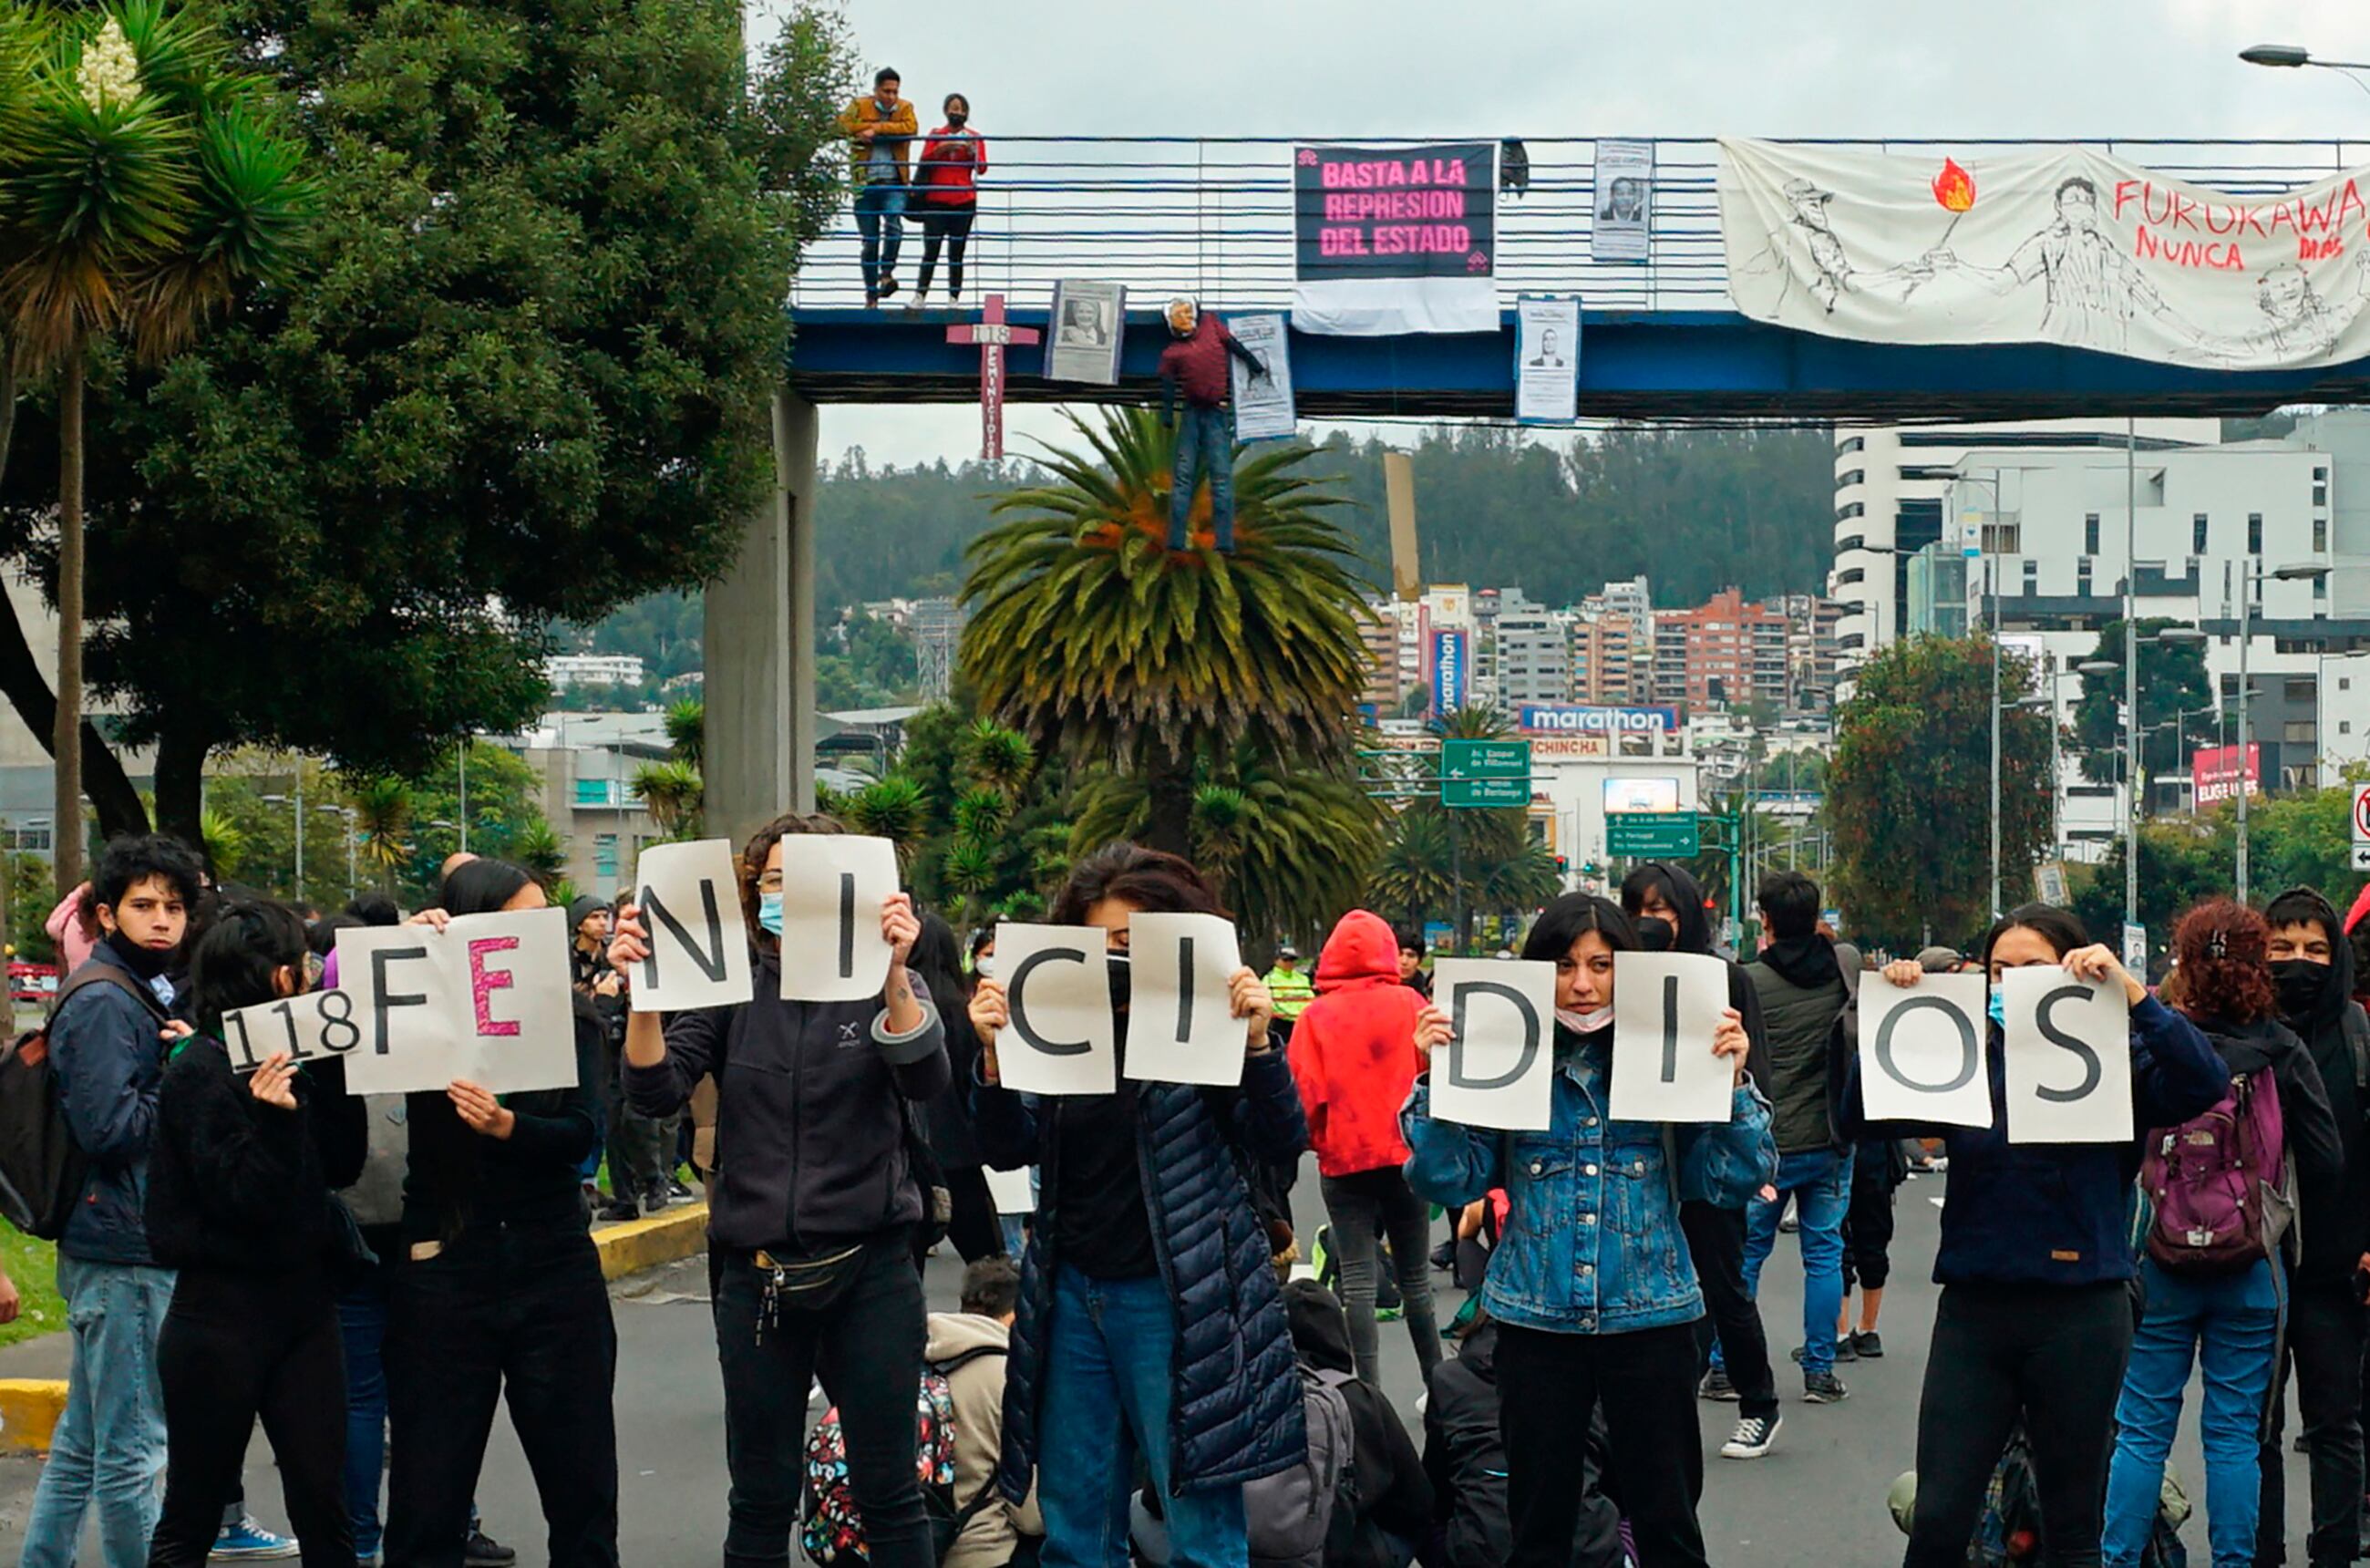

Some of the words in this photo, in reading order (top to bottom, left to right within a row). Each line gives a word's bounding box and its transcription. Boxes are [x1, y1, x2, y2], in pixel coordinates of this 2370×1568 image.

[1323, 160, 1405, 188] BASTA
[1410, 160, 1429, 185] A
[1434, 159, 1467, 186] LA
[1325, 190, 1465, 222] REPRESION
[2114, 178, 2366, 240] FURUKAWA
[1320, 227, 1369, 256] DEL
[1373, 224, 1471, 255] ESTADO
[2135, 224, 2245, 272] NUNCA
[974, 326, 1010, 344] 118
[1439, 633, 1458, 715] marathon
[1533, 708, 1664, 730] marathon
[225, 990, 361, 1072] 118
